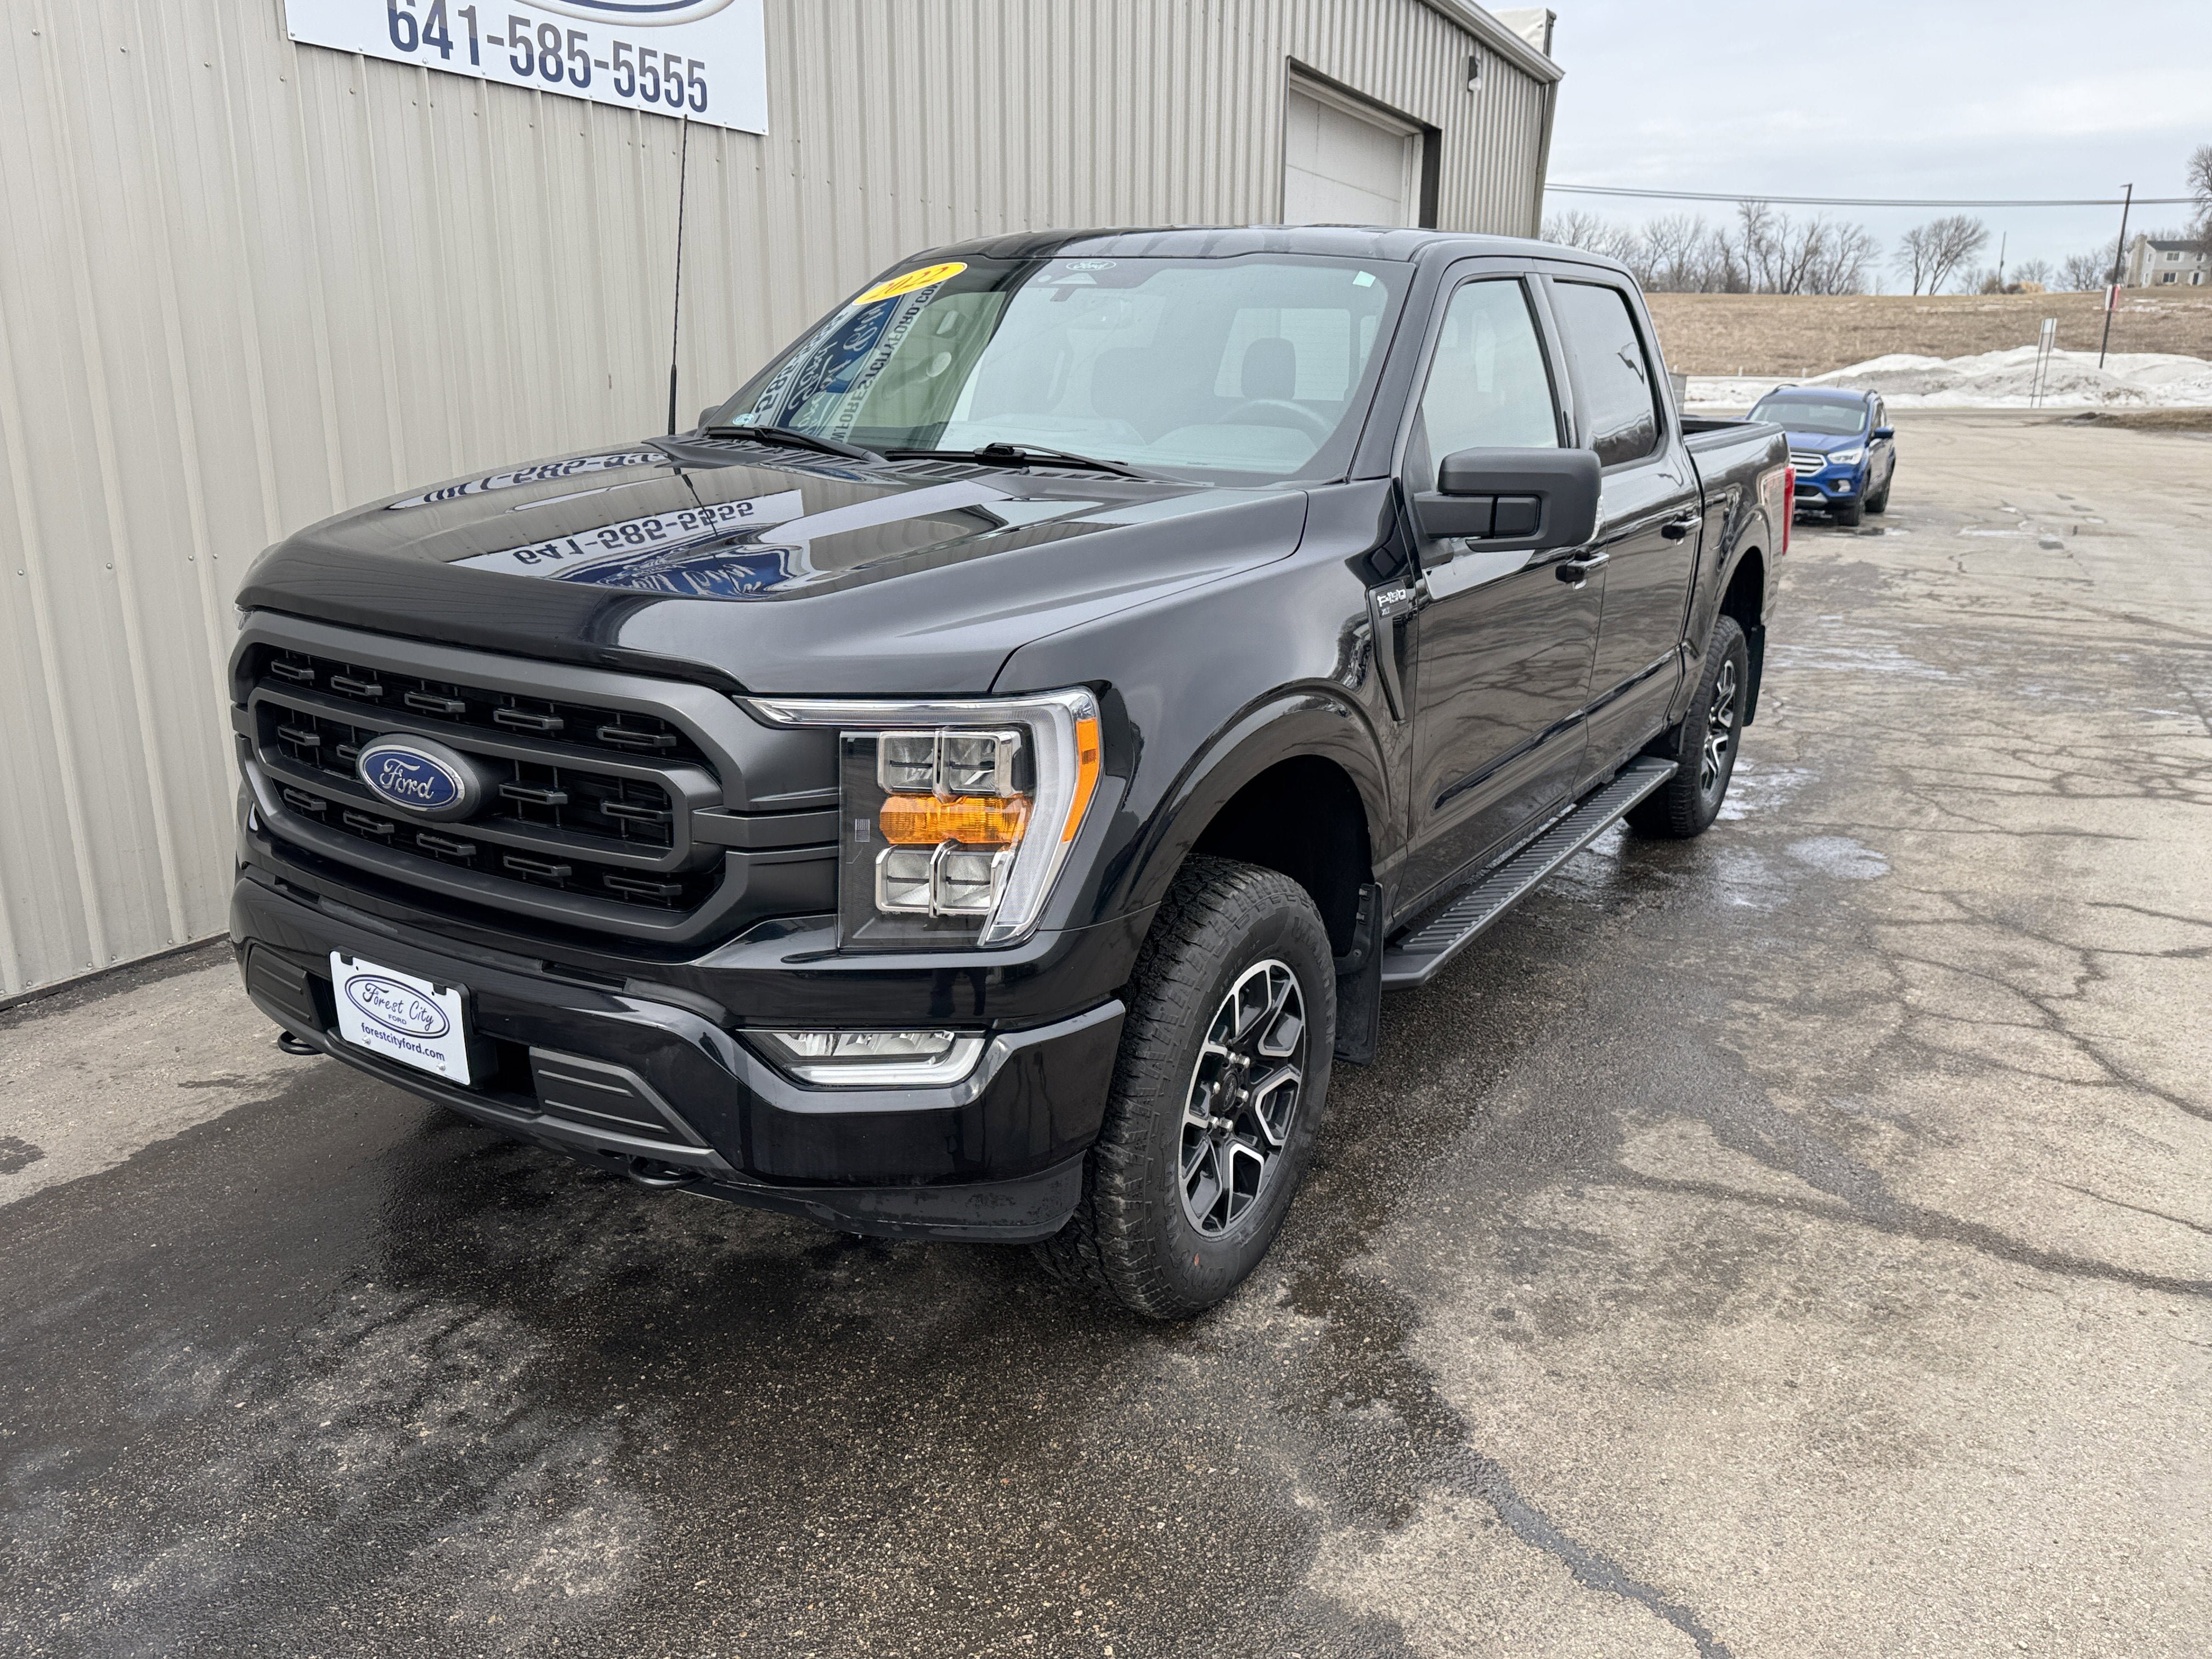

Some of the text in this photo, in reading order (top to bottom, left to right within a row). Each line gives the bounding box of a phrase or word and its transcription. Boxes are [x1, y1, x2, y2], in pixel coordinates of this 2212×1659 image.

[387, 0, 708, 112] 641-585-5555
[865, 267, 949, 301] 2022
[1381, 607, 1391, 616] XLT
[380, 758, 435, 799] Ford
[363, 983, 434, 1031] Forest City
[388, 1014, 407, 1025] FORD
[361, 1023, 445, 1062] forestcityford.com
